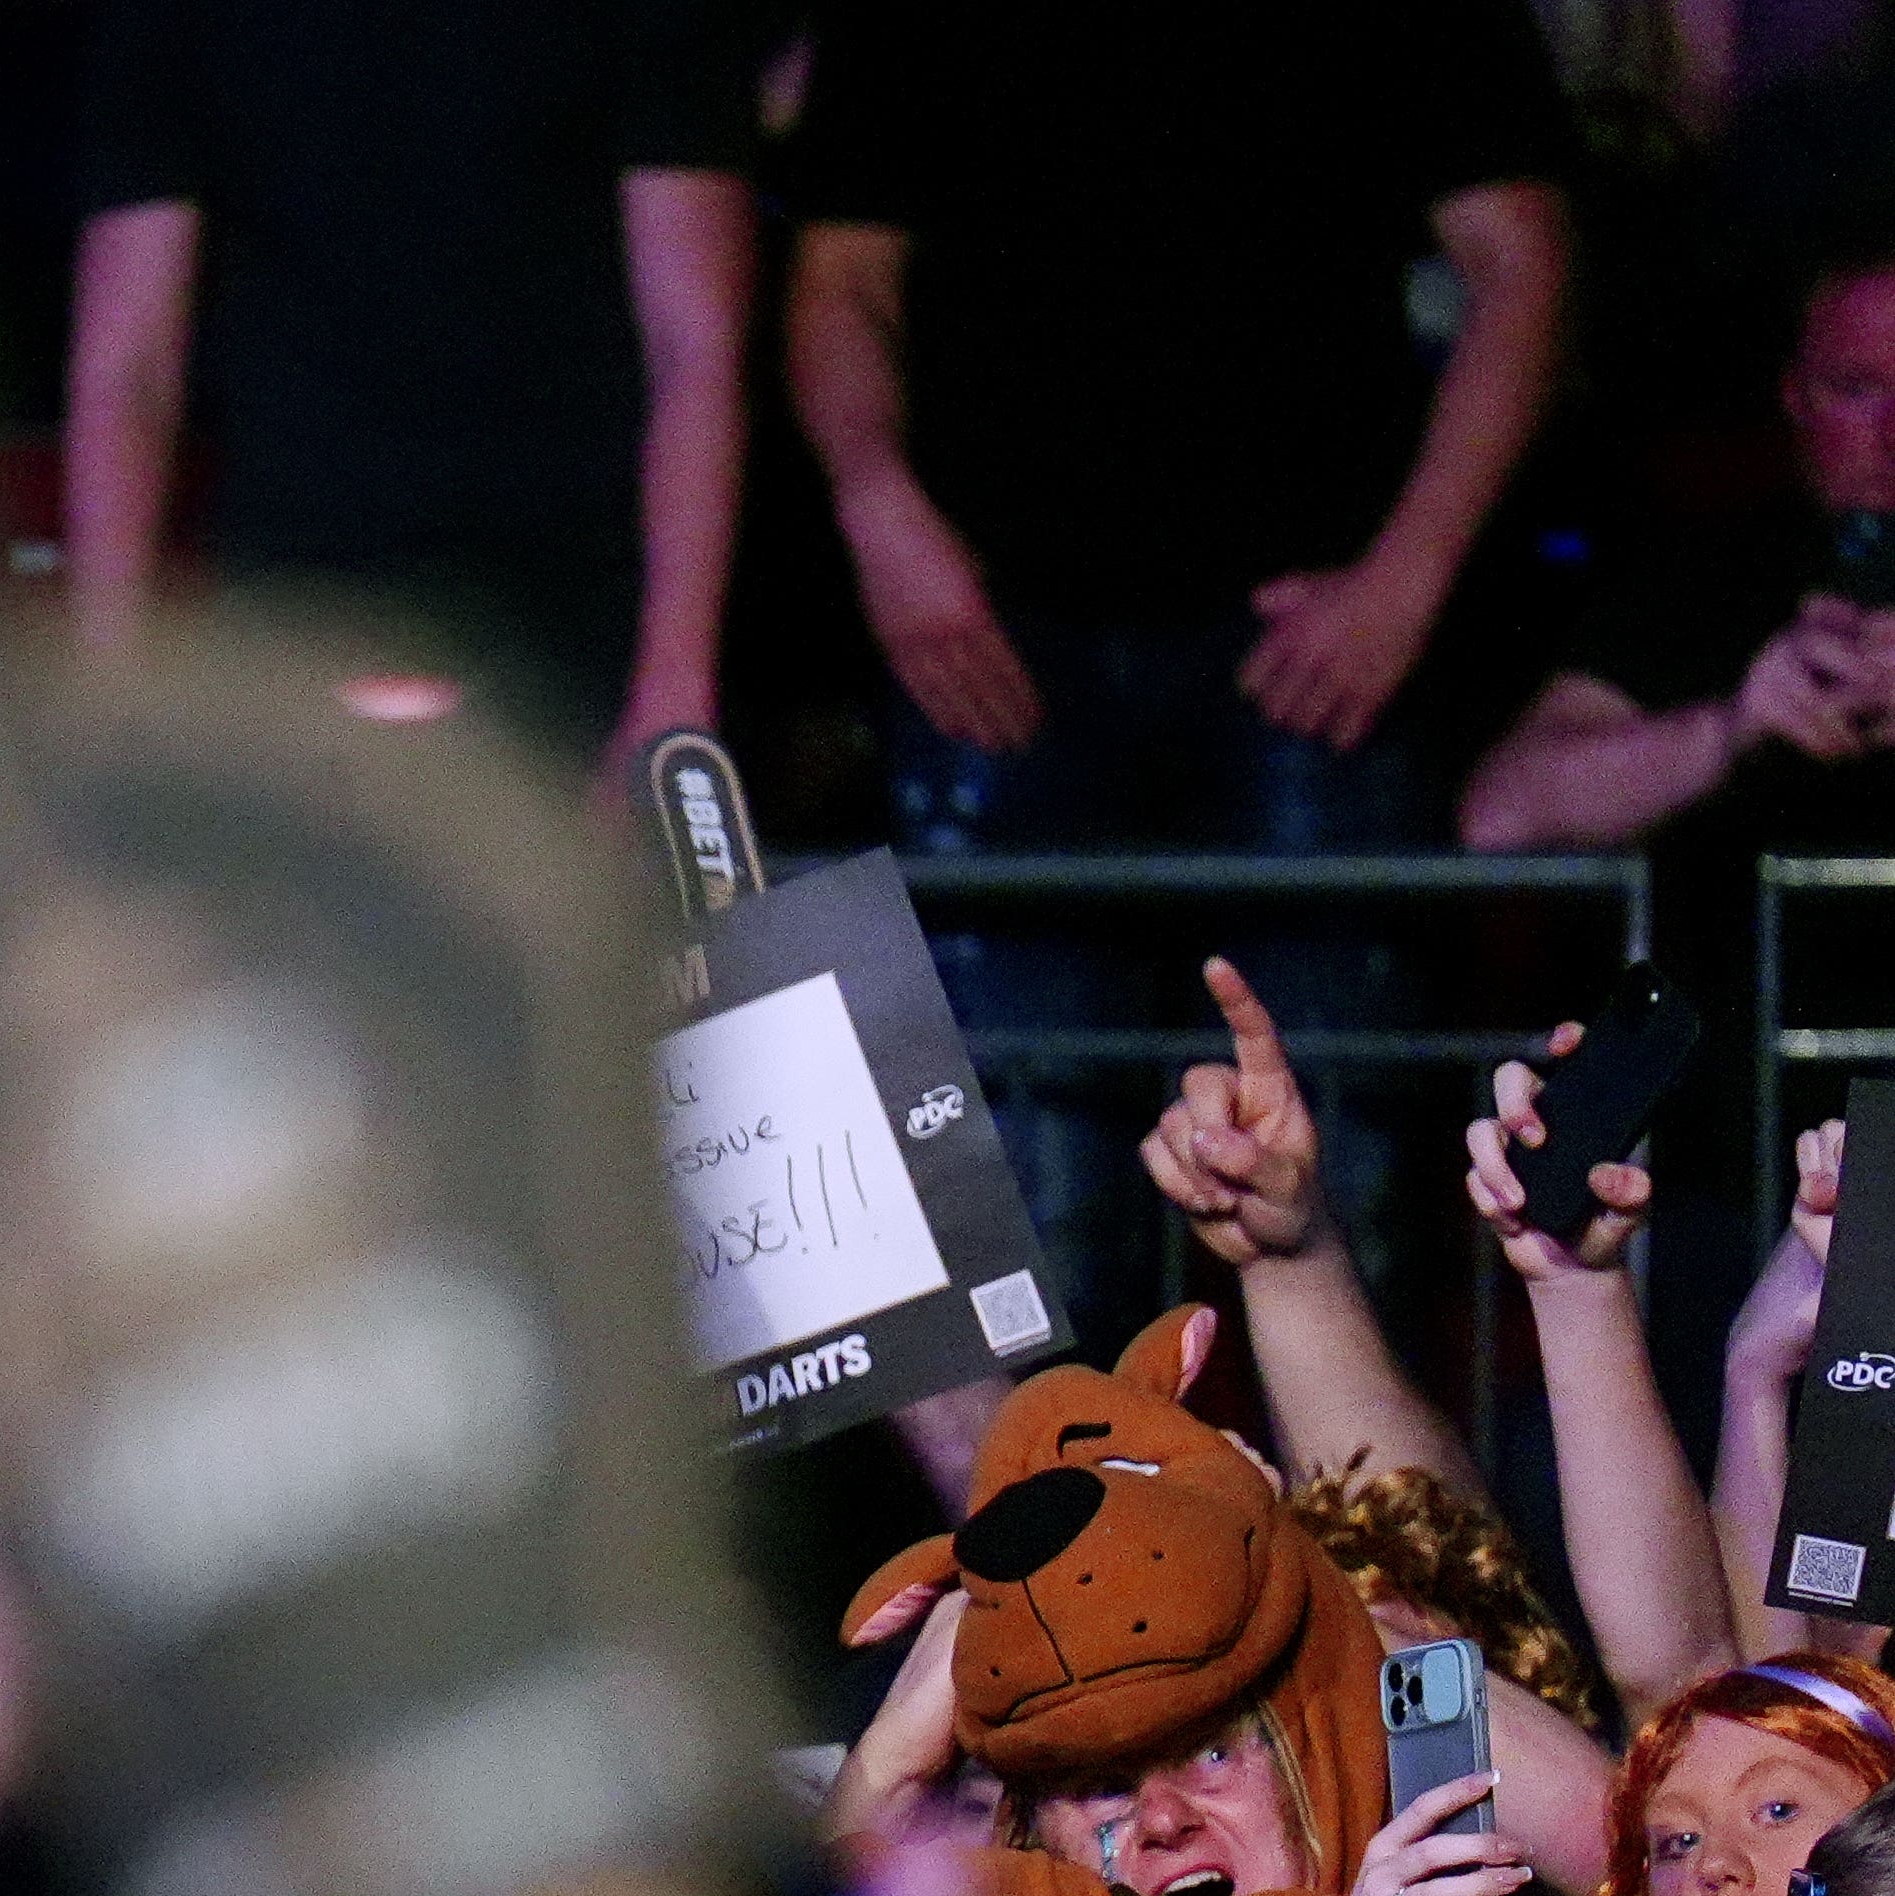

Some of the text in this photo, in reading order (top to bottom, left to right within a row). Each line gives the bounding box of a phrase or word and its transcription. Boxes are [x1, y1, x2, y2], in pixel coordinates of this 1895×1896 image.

[908, 1097, 964, 1135] PDC
[736, 1333, 873, 1417] DARTS
[1835, 1360, 1895, 1388] PDC
